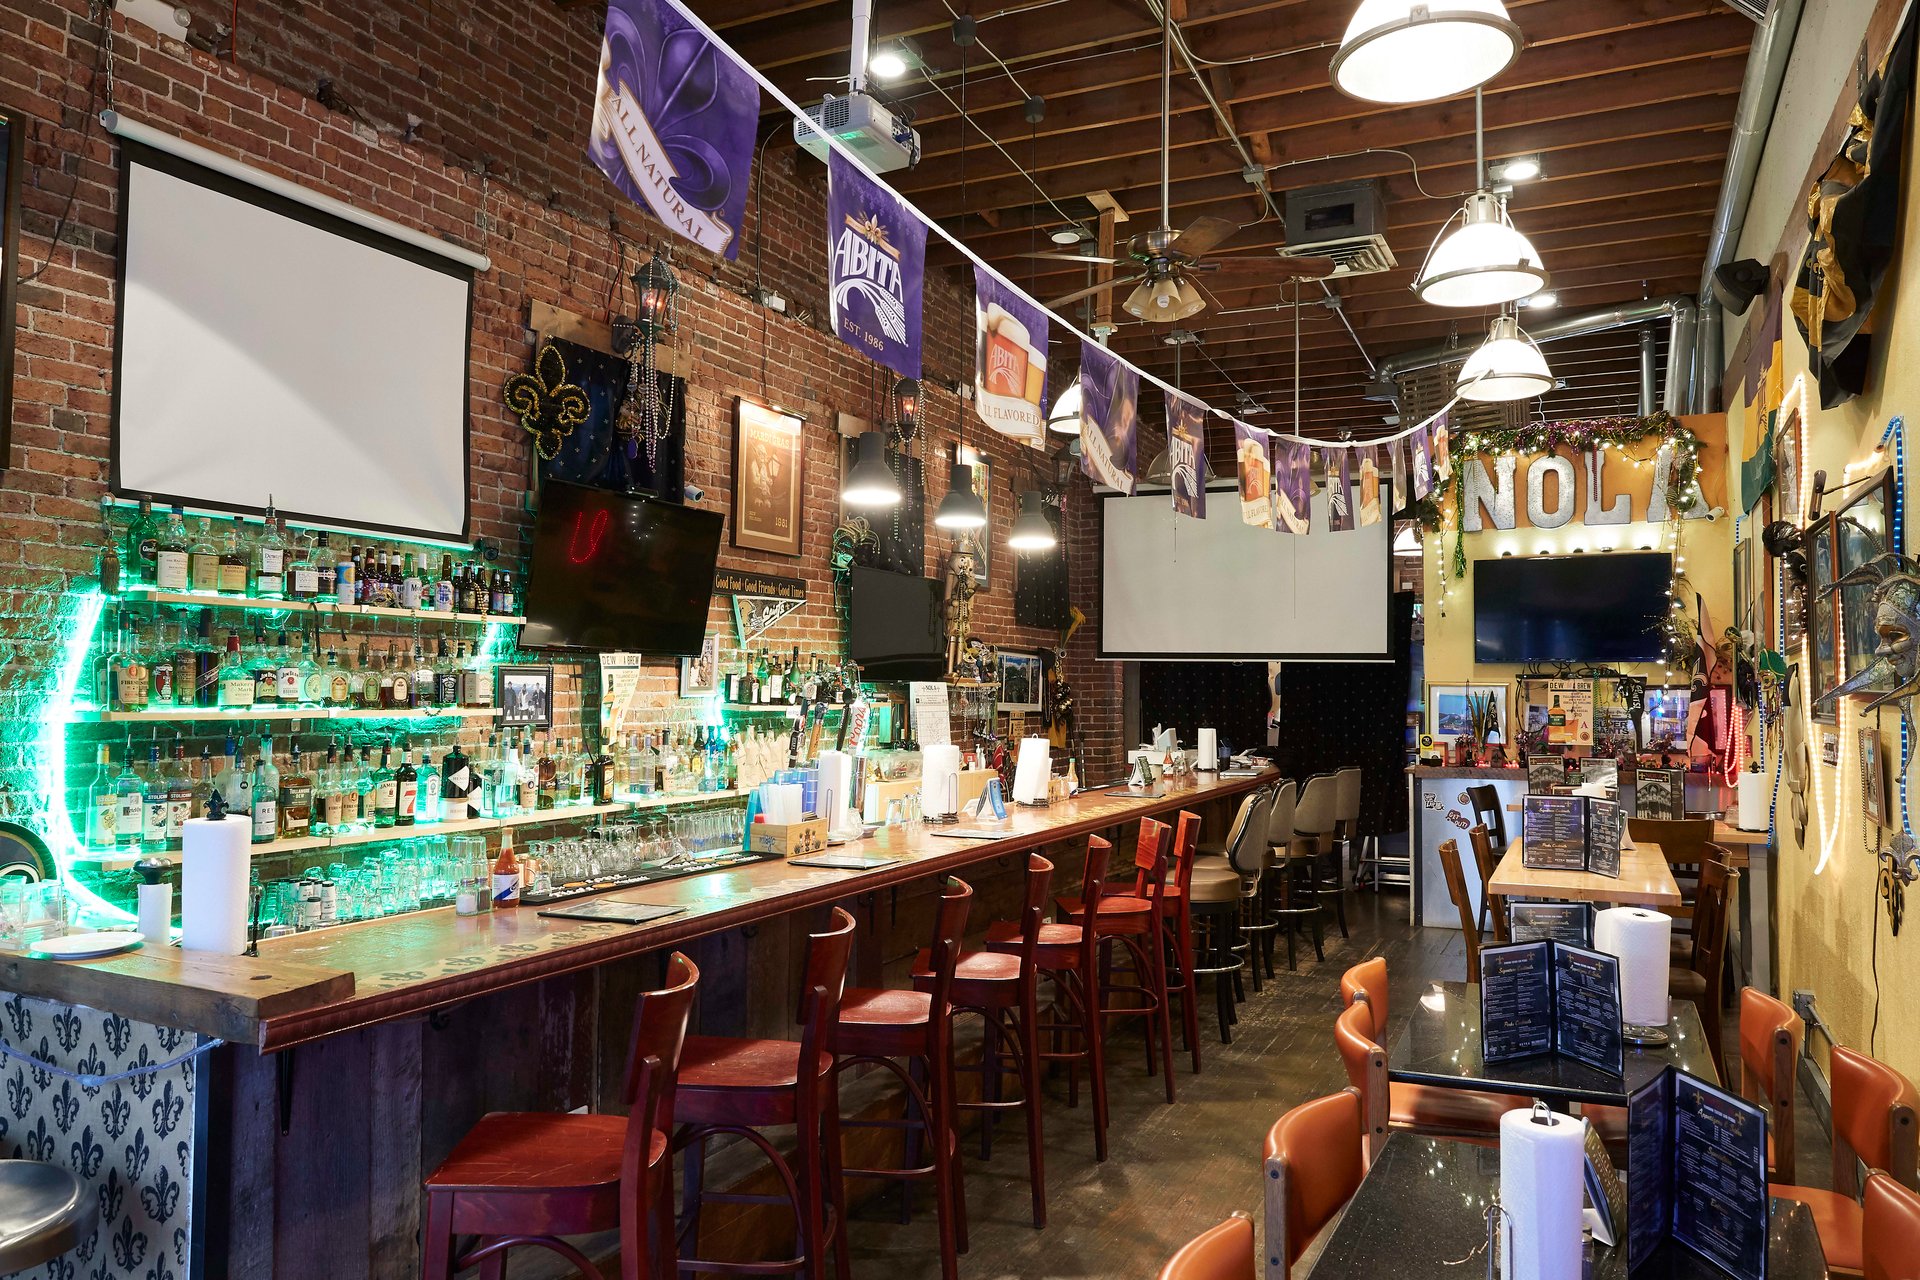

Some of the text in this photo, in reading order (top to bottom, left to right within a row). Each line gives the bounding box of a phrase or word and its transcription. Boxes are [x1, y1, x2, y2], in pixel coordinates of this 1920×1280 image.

[611, 96, 707, 247] ALL NATURAL
[834, 227, 905, 303] ABITA
[843, 317, 885, 353] EST. 1986
[990, 343, 1019, 375] ABITA
[994, 408, 1041, 426] FLAVORED
[773, 434, 790, 449] GRAS
[1169, 436, 1196, 470] ABITA
[1097, 445, 1124, 491] NATURAL
[1463, 446, 1710, 532] NOLA
[715, 573, 804, 598] Good Food Good Friends Good Times
[849, 706, 866, 747] Coors
[404, 790, 416, 814] 7
[1448, 811, 1460, 820] GET
[1454, 820, 1468, 829] OUT!
